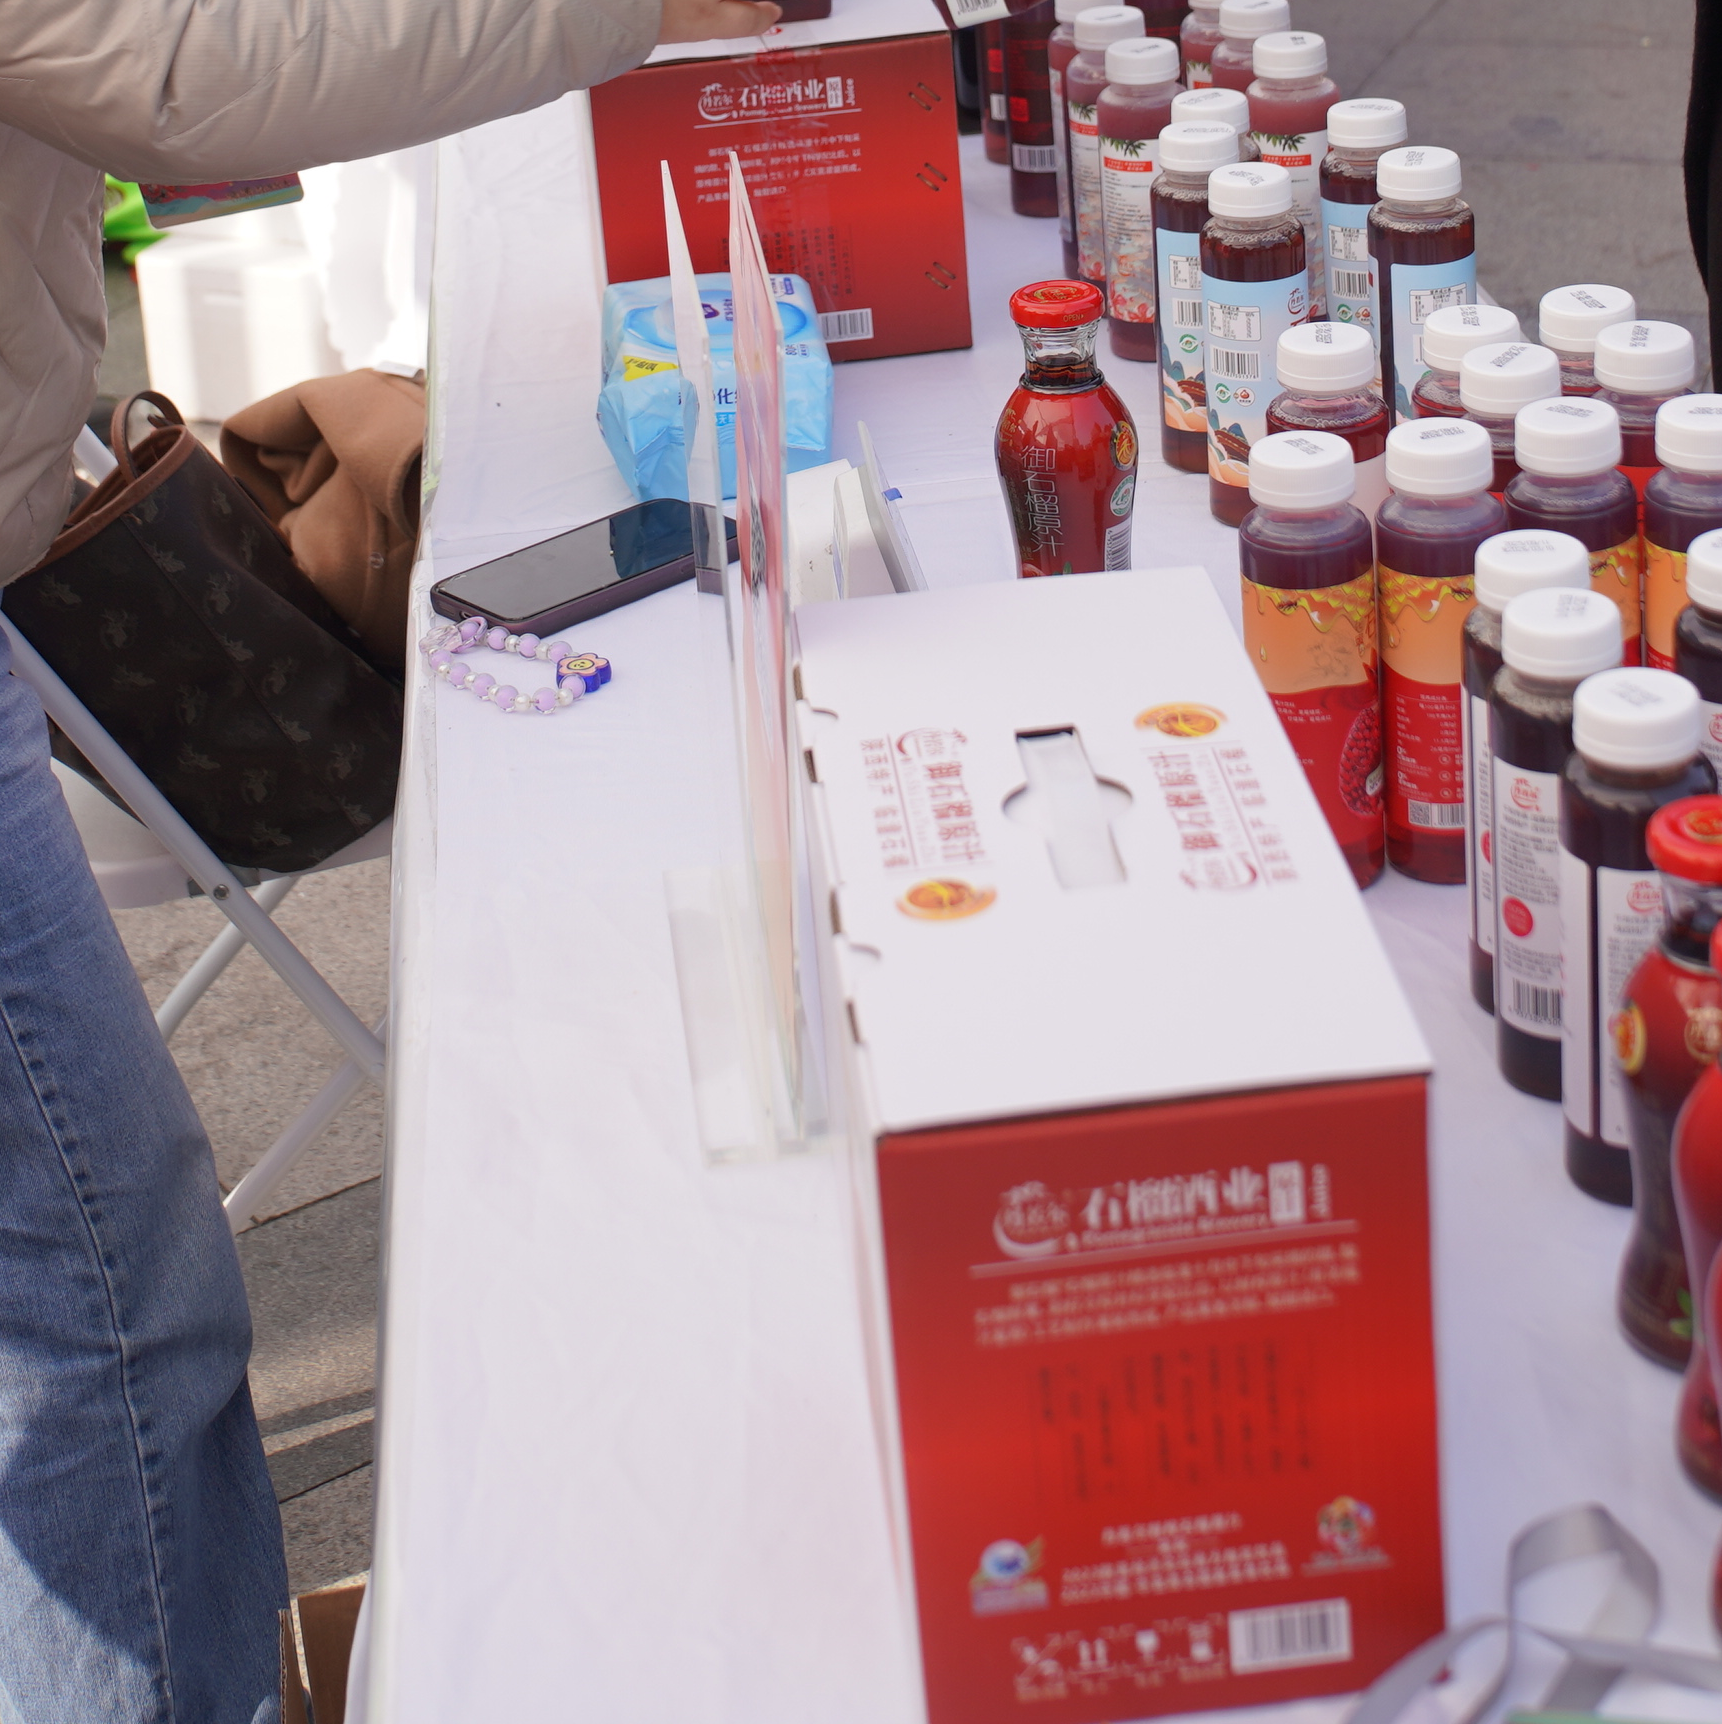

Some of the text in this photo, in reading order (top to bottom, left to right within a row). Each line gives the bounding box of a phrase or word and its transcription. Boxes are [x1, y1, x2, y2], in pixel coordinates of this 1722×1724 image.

[1063, 313, 1082, 323] OPEN
[1021, 445, 1065, 558] 御石榴原汁
